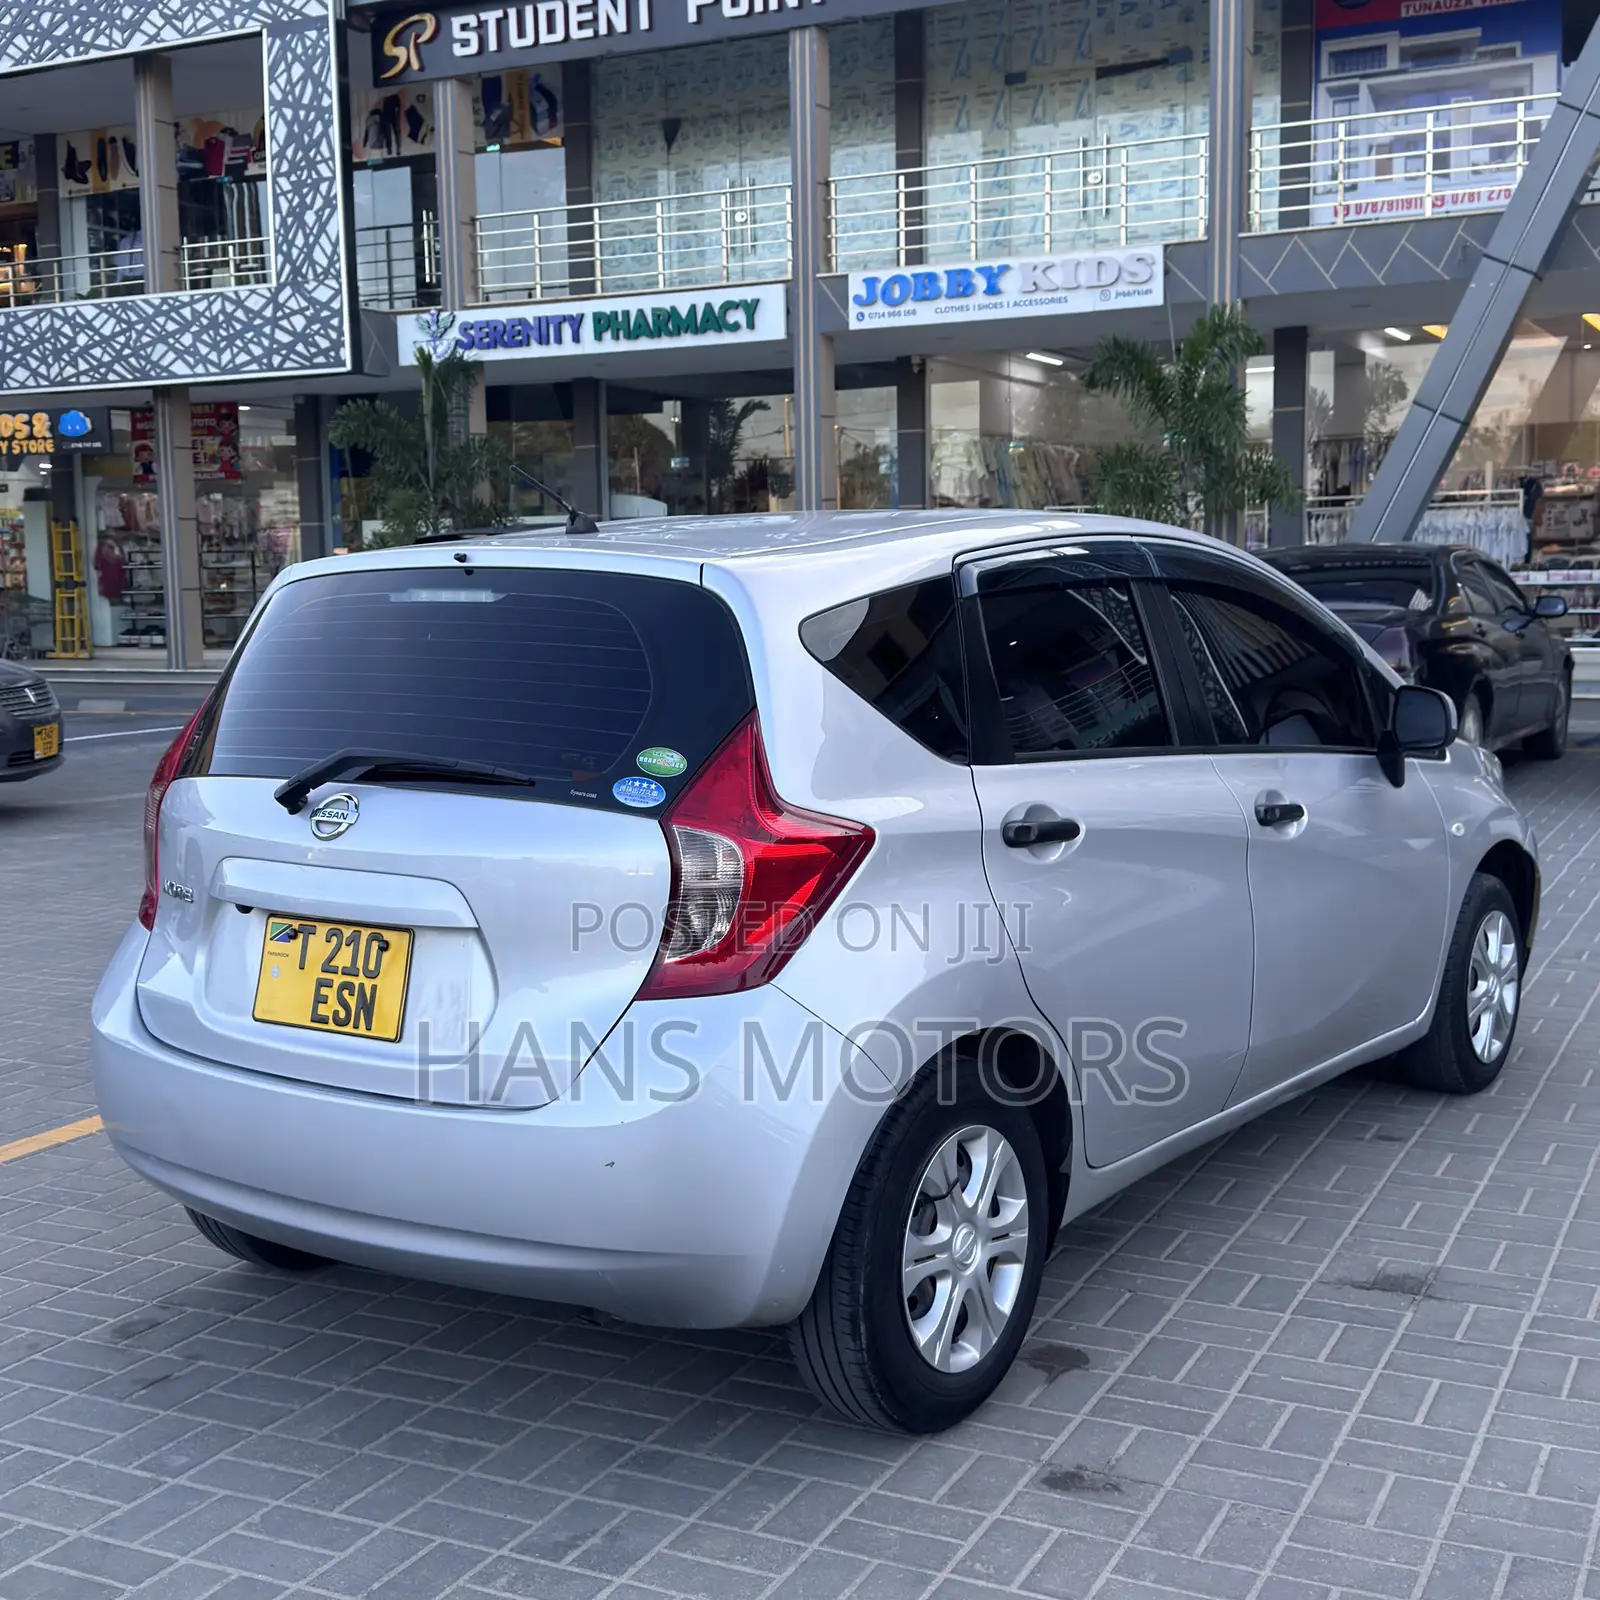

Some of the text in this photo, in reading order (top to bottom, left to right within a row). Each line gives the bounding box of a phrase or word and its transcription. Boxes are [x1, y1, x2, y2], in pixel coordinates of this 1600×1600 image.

[450, 0, 653, 57] STUDENT
[852, 252, 1156, 307] JOBBY KIDS
[934, 295, 1068, 314] CLOTHES SHOES ACCESSORIES
[456, 298, 760, 351] SERENITY PHARMACY
[11, 438, 55, 455] STORE
[31, 411, 53, 438] &
[311, 807, 349, 820] NISSAN
[297, 923, 385, 979] T 210
[310, 977, 378, 1031] ESN
